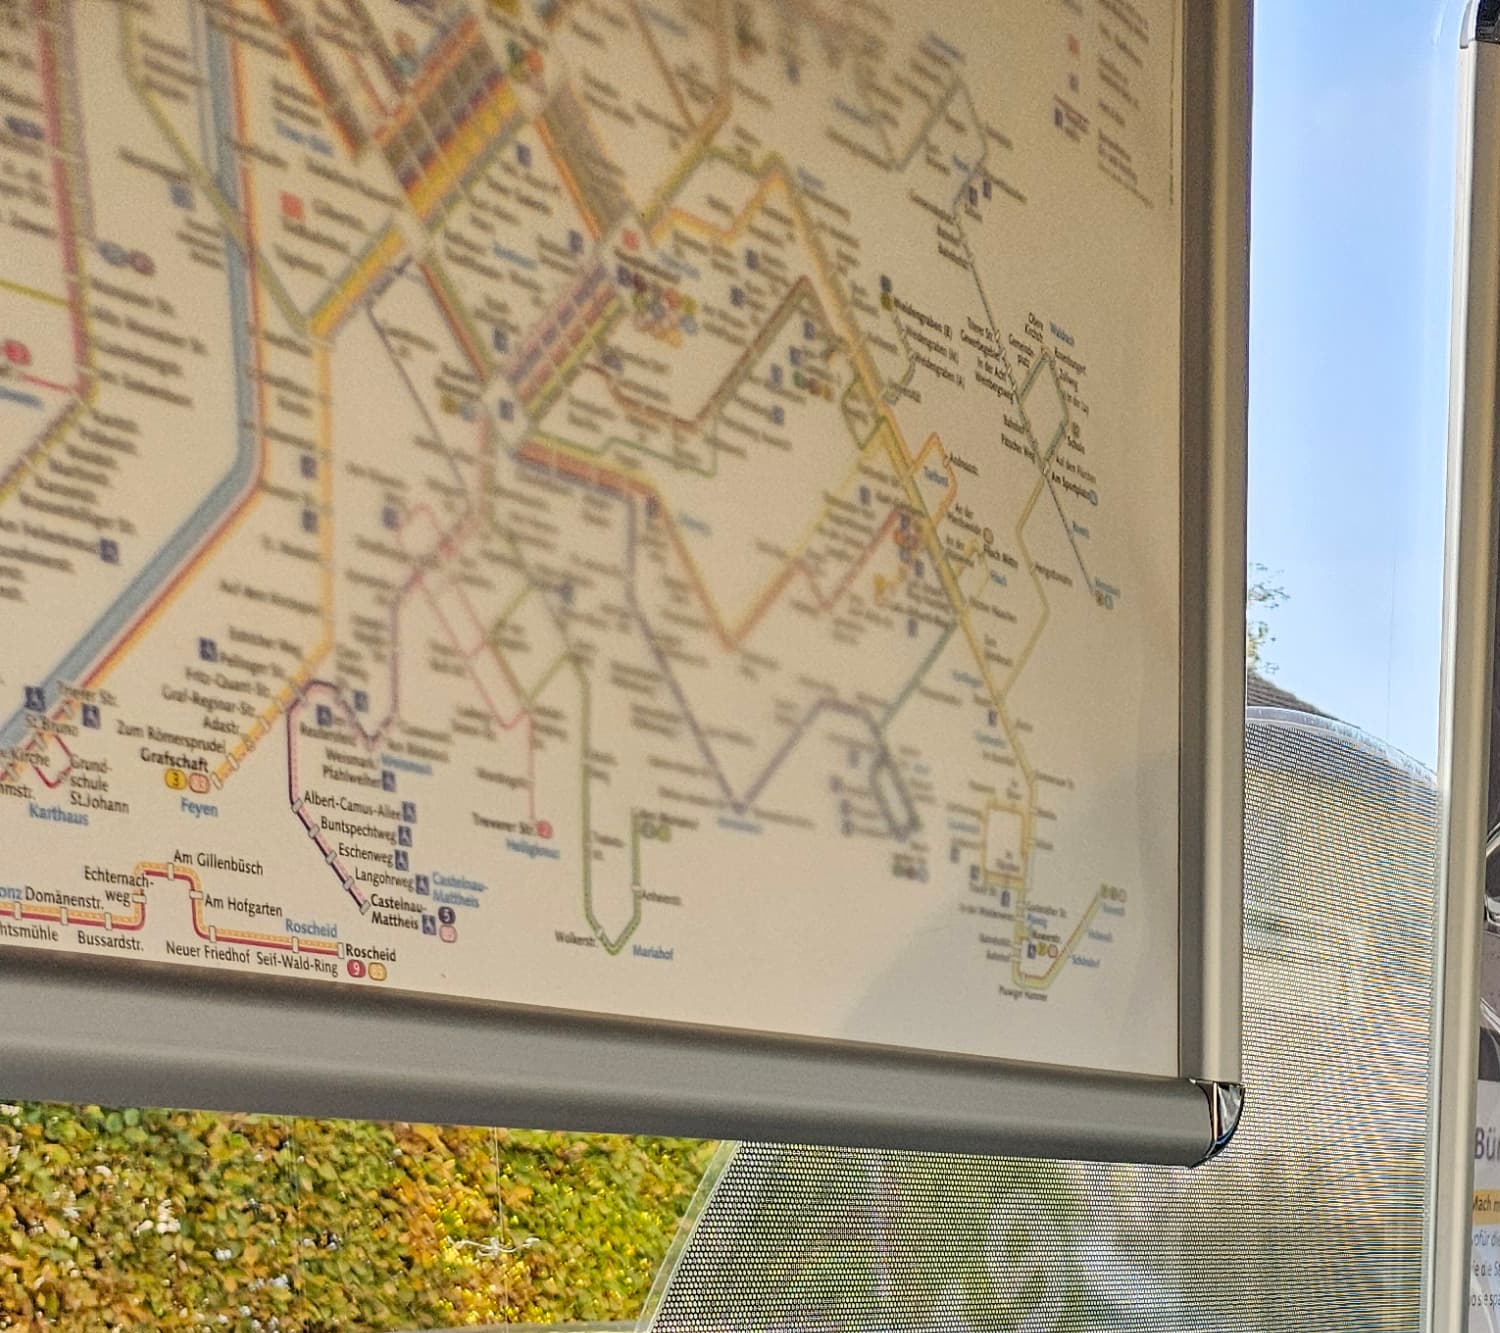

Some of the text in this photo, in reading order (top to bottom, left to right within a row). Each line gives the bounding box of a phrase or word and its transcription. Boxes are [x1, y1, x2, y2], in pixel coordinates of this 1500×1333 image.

[140, 747, 209, 773] Grafschaft
[28, 802, 89, 826] Karthaus
[180, 797, 219, 818] Feyen
[320, 816, 397, 845] Buntspechtweg
[173, 849, 264, 876] Am Gillenbüsch
[338, 842, 393, 867] Eschenweg
[84, 865, 154, 888] Echternach-
[355, 867, 414, 891] Langohrweg
[25, 885, 105, 911] Domänenstr.
[105, 890, 131, 908] weg
[204, 893, 283, 917] Am Hofgarten
[370, 893, 428, 913] Castelnau-
[0, 920, 59, 941] htsmühle
[285, 917, 338, 938] Roscheid
[371, 911, 419, 931] Mattheis
[78, 930, 144, 952] Bussardstr.
[166, 940, 201, 959] Neuer
[204, 944, 250, 963] Friedhof
[345, 943, 397, 962] Roscheid
